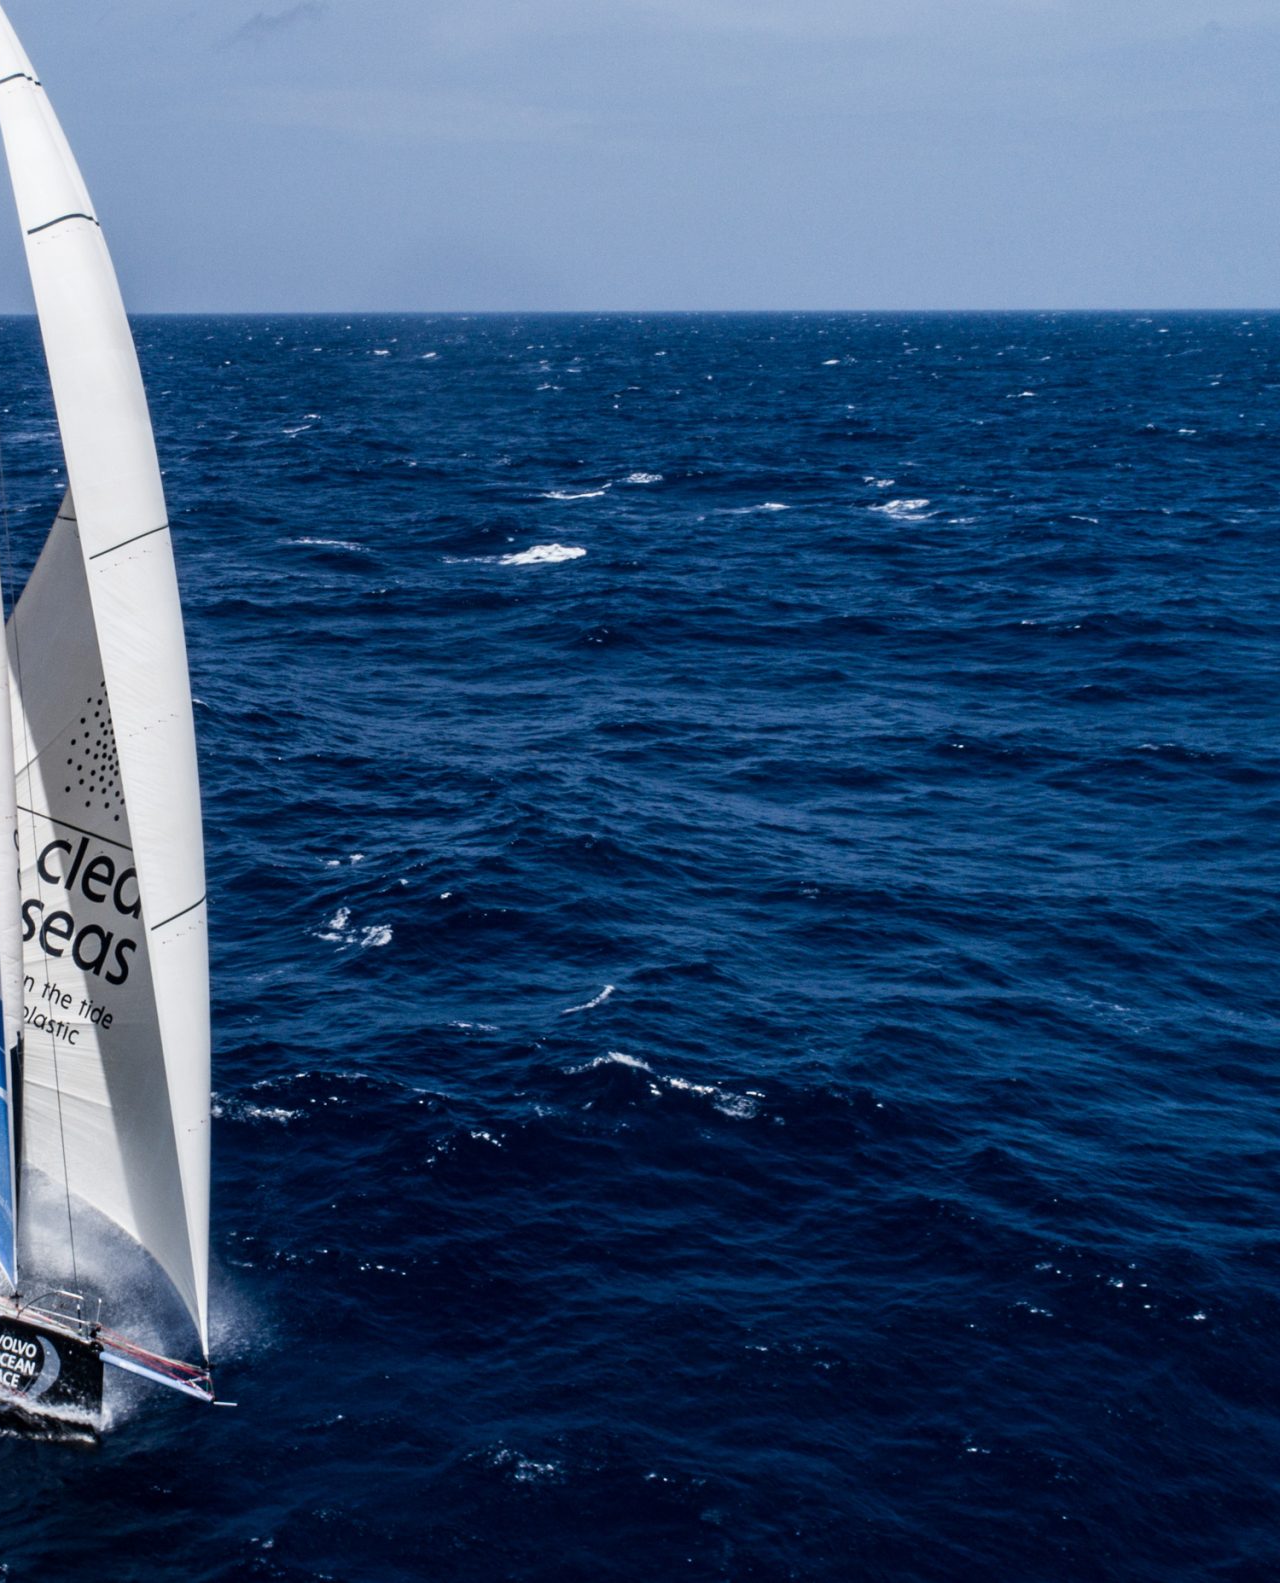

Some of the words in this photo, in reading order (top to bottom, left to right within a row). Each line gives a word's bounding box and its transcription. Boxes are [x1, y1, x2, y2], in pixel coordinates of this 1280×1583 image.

[37, 836, 142, 920] clea
[21, 898, 137, 985] seas
[41, 982, 73, 1010] the
[78, 999, 113, 1030] tide
